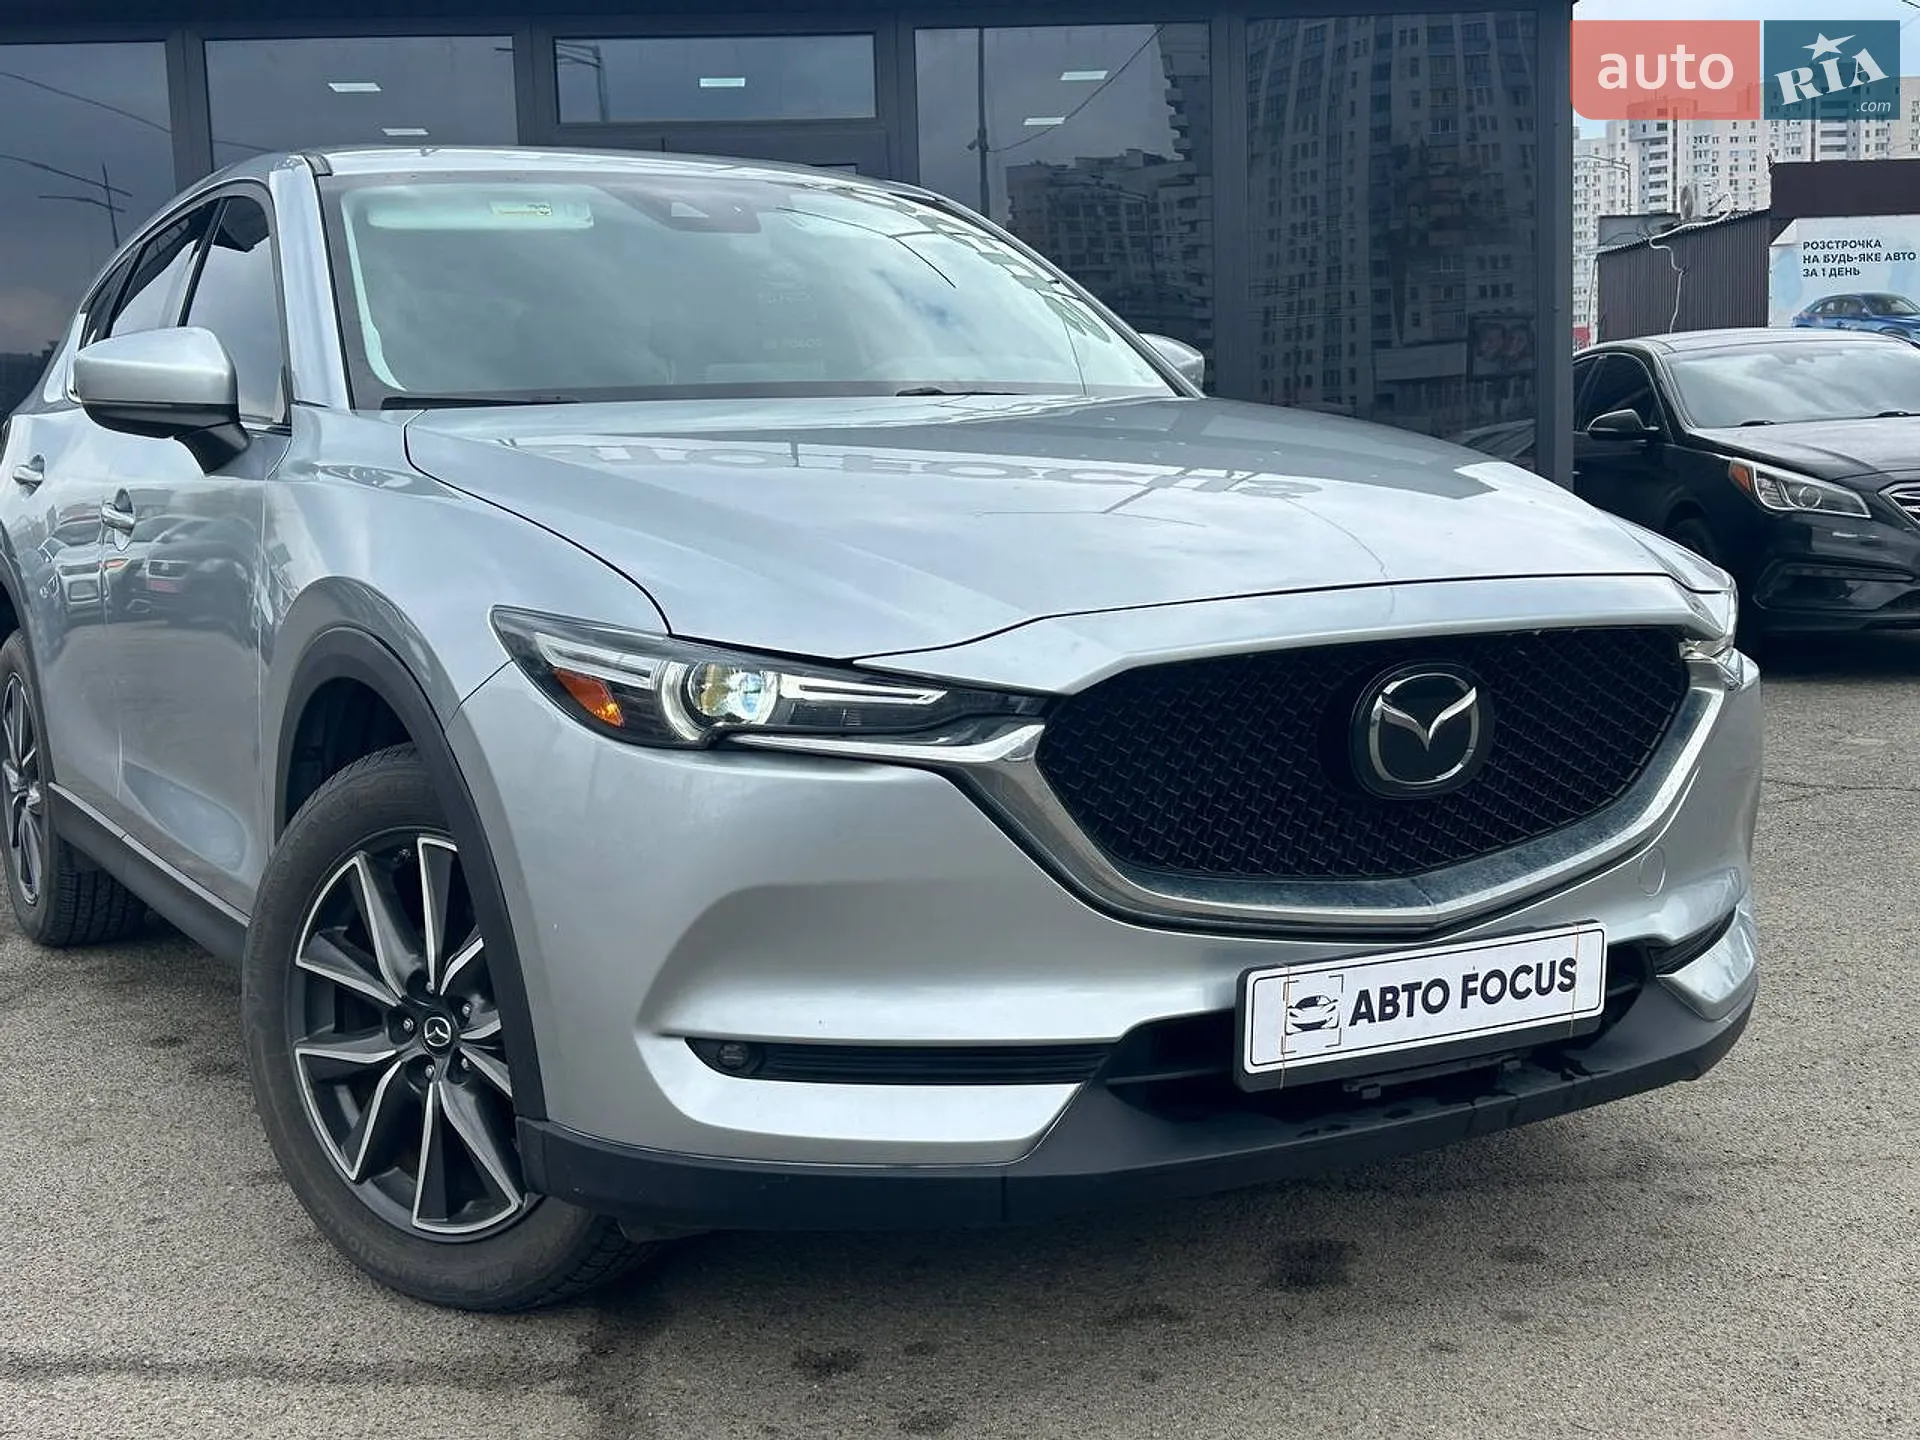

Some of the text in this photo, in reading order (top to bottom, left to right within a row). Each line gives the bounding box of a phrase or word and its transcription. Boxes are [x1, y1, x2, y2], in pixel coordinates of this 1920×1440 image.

[1803, 239, 1882, 250] РОЗСТРОЧКА
[1803, 252, 1917, 264] НА БУДЬ-ЯКЕ АВТО
[1802, 267, 1860, 278] ЗА 1 ДЕНЬ
[1348, 957, 1577, 1027] АВТО FOCUS
